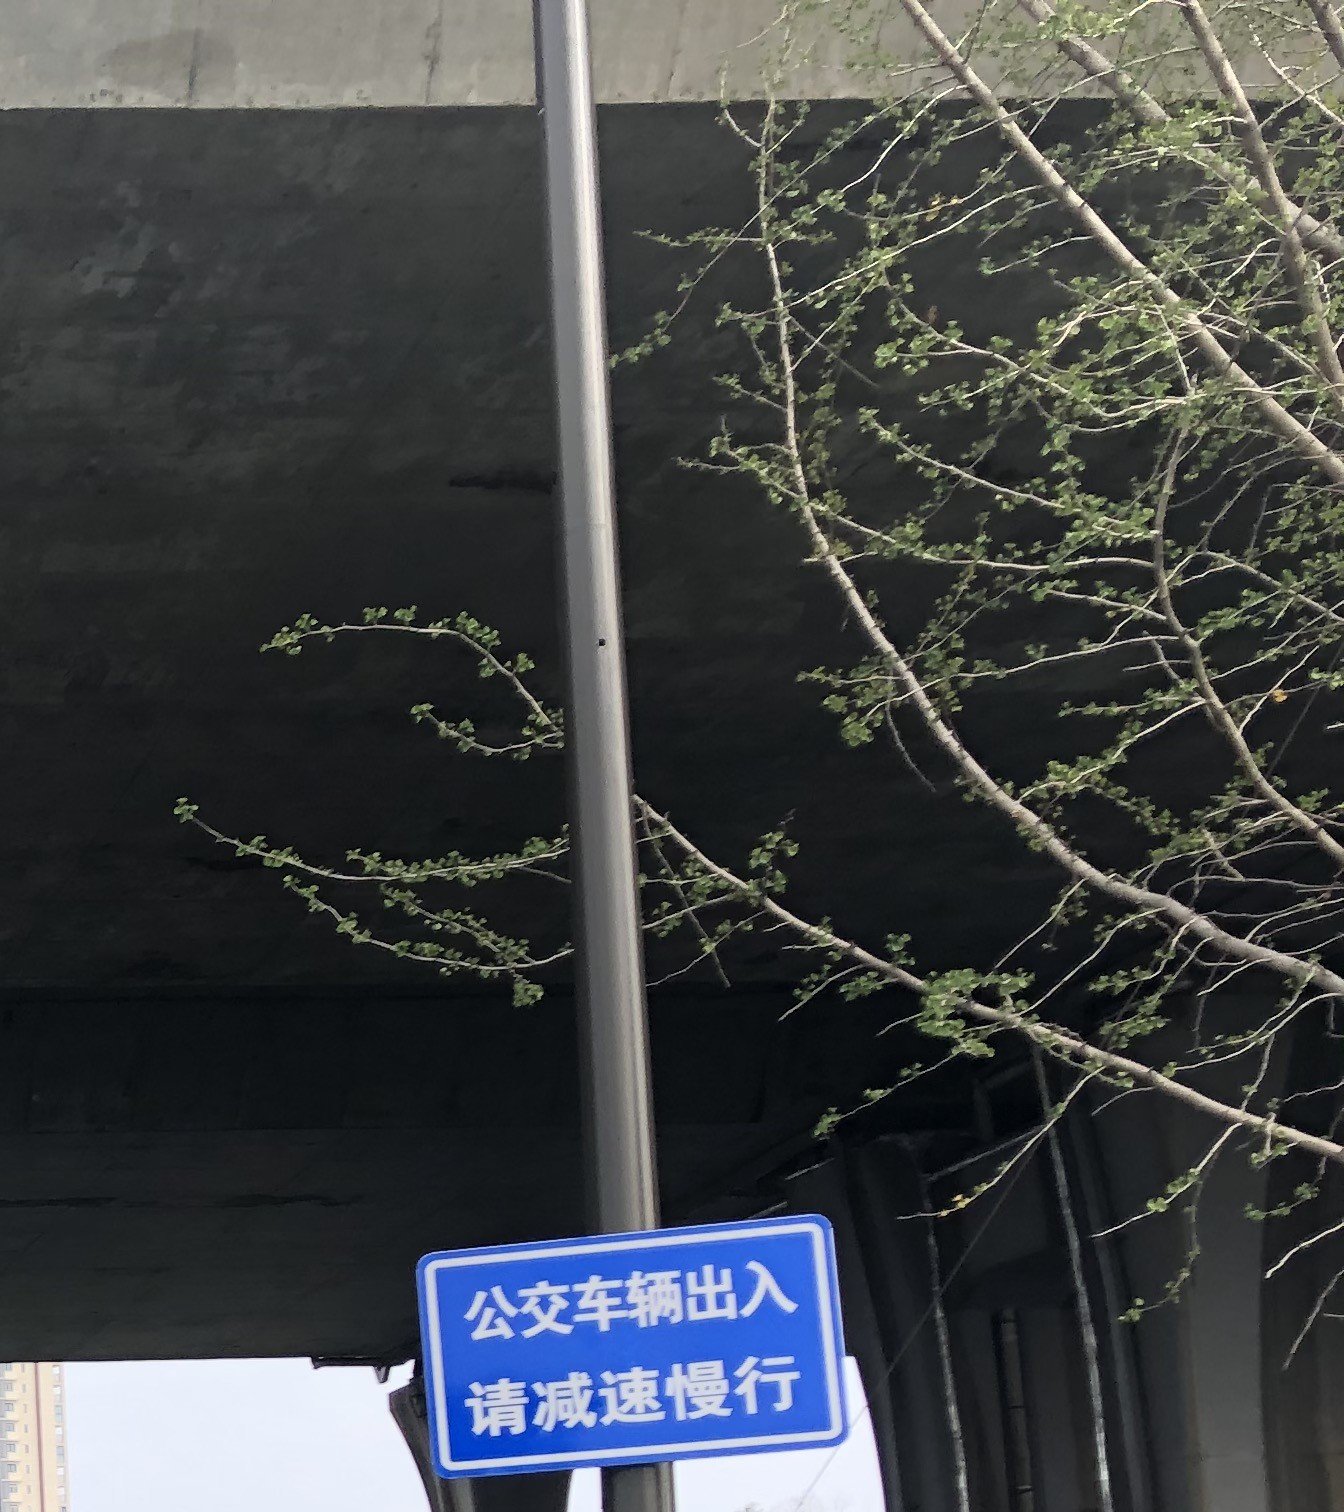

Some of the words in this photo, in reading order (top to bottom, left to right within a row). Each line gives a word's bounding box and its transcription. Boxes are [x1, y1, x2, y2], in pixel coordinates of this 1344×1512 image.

[463, 1259, 799, 1342] 公交车辆出入
[464, 1354, 802, 1438] 请减速慢行
